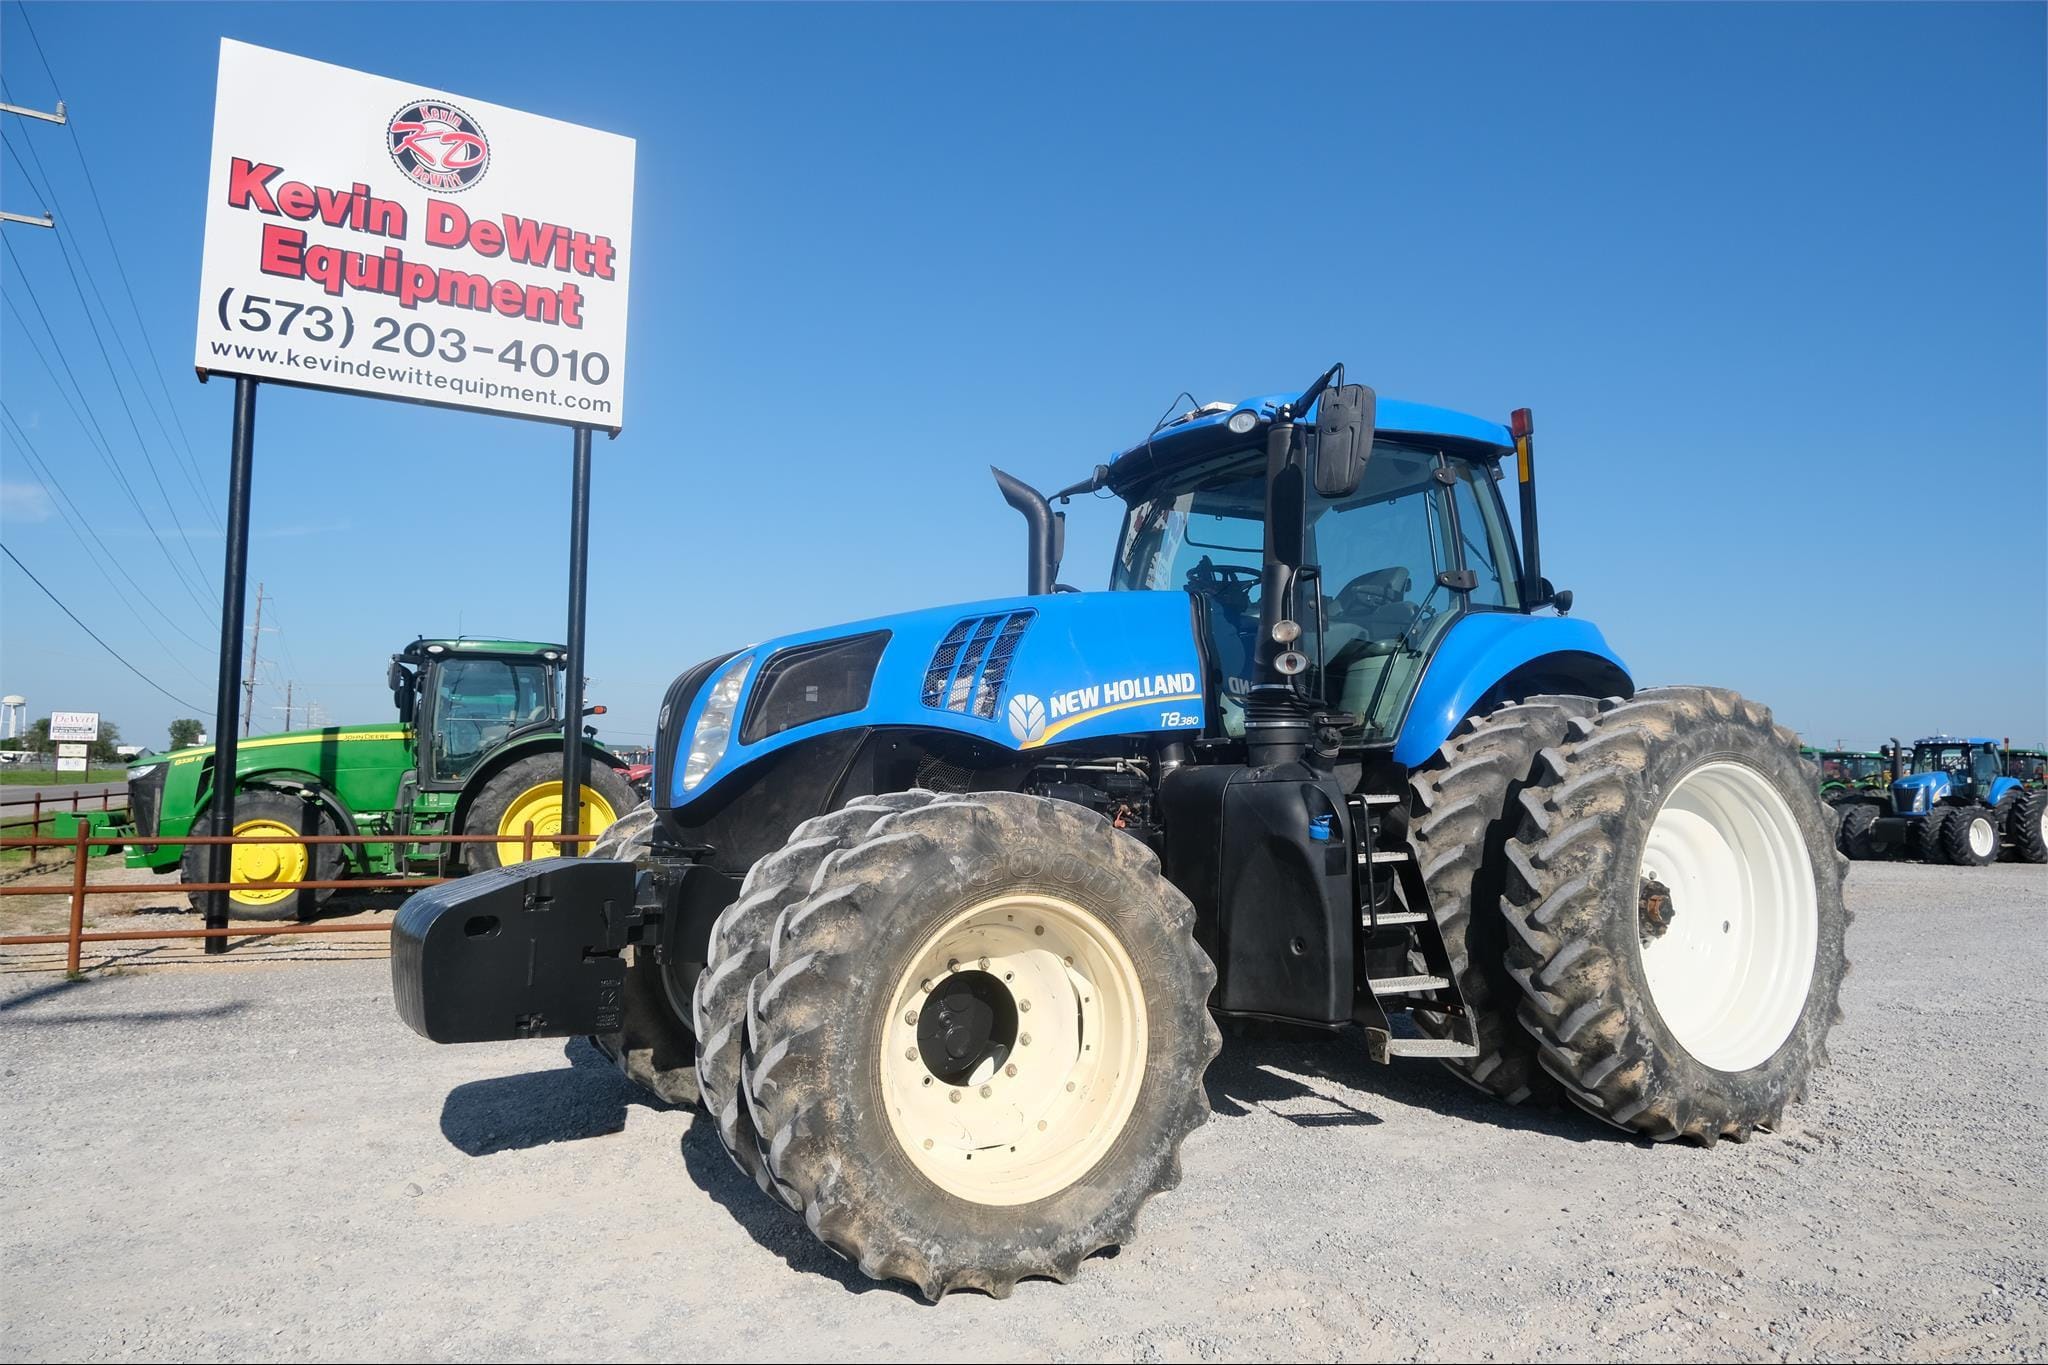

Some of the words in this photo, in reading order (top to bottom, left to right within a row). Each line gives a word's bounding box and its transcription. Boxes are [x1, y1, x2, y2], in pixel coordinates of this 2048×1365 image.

[419, 105, 463, 128] Kevin
[411, 165, 463, 188] DeWitt
[228, 156, 408, 240] Kevin
[425, 197, 616, 281] DeWitt
[259, 223, 584, 329] Equipment
[217, 287, 355, 349] (573)
[372, 316, 610, 386] 203-4010
[210, 340, 612, 413] www.kevindewittequipment.com
[1051, 686, 1099, 718] NEW
[1104, 673, 1195, 704] HOLLAND
